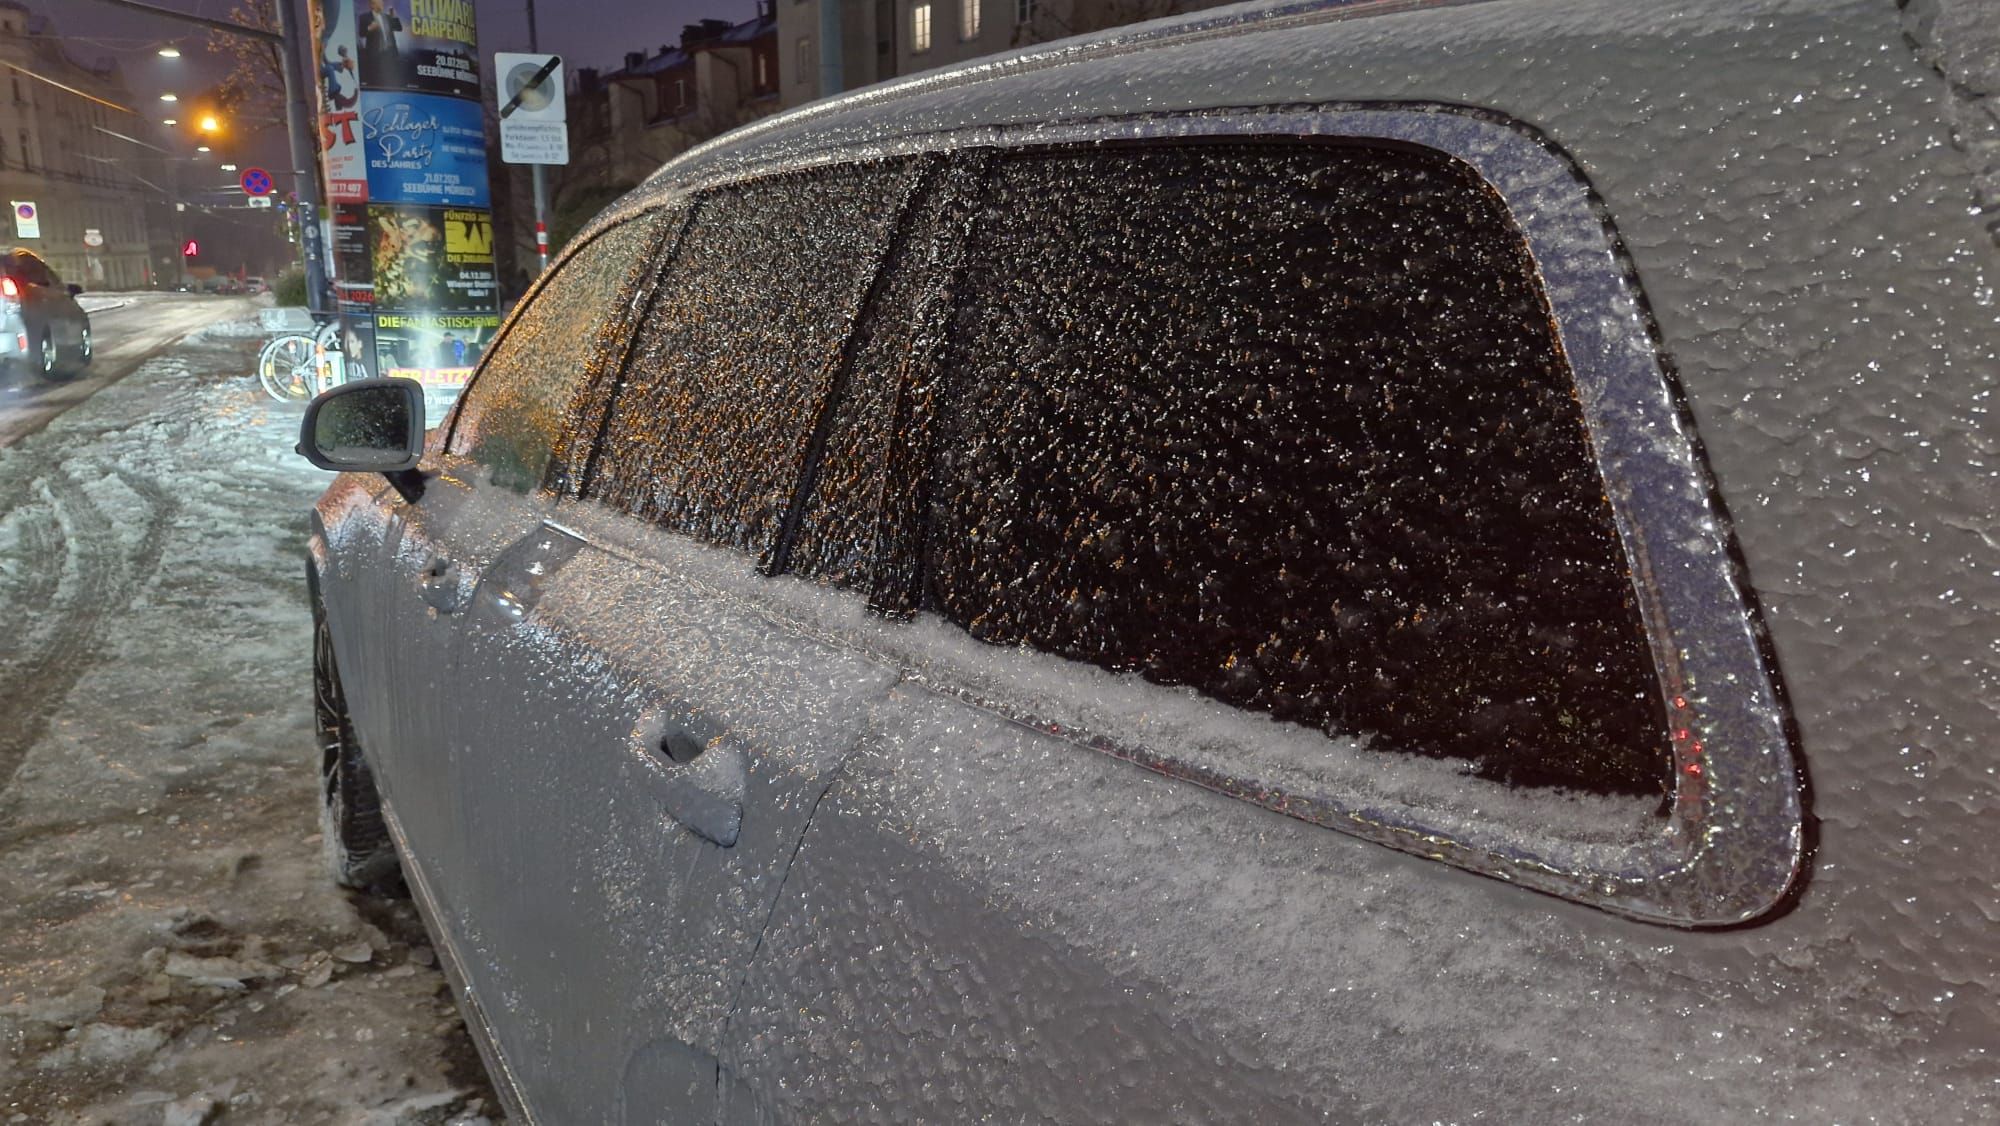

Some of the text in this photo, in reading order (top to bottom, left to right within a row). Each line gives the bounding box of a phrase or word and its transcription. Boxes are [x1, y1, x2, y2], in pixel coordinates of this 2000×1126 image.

[379, 134, 433, 166] Party
[371, 160, 422, 169] DES JAHRES
